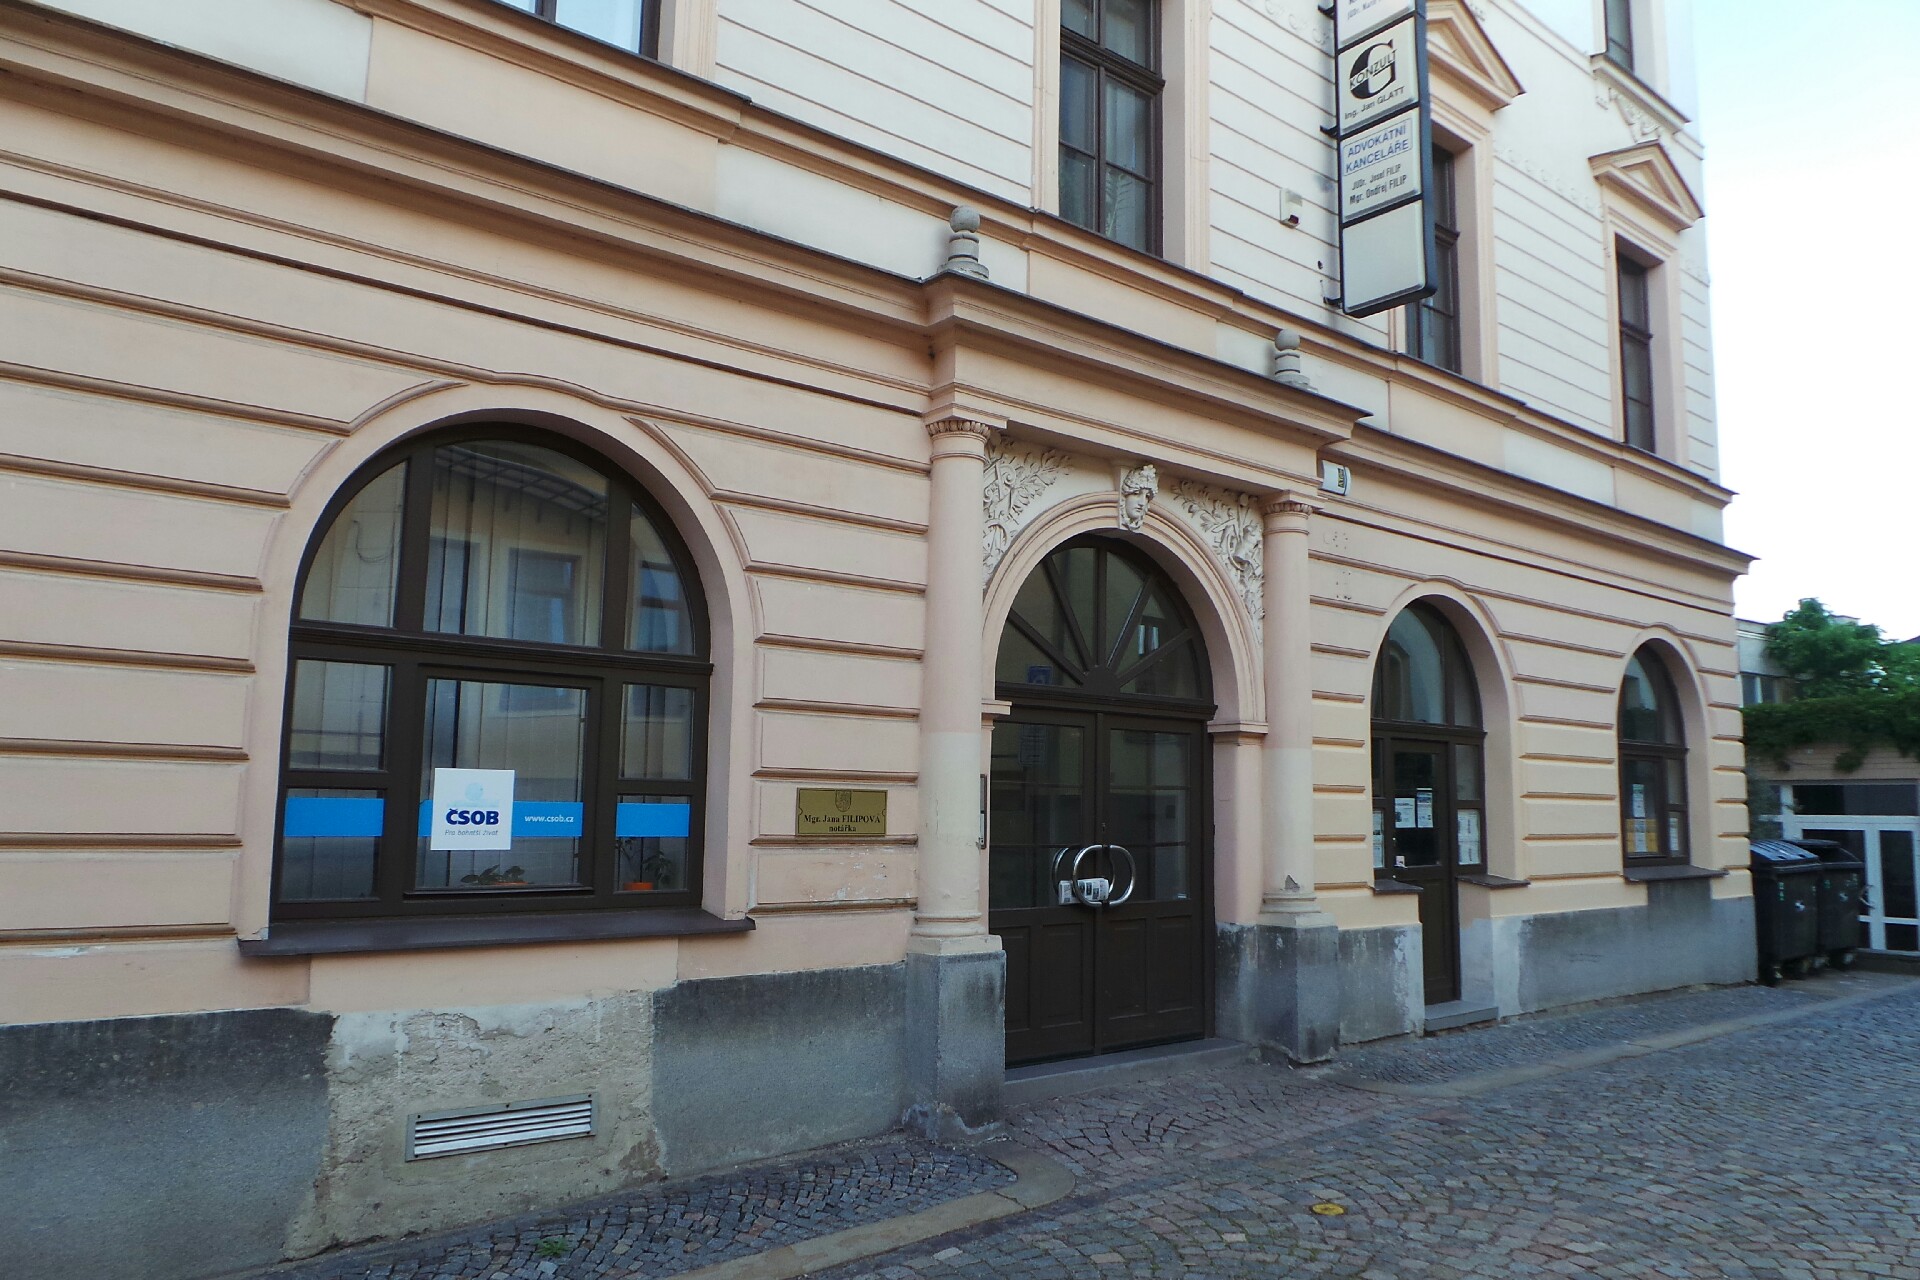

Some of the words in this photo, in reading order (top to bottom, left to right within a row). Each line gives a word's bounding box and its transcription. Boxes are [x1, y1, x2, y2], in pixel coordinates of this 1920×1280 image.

[1350, 49, 1397, 88] KONZULT
[1345, 110, 1358, 120] Ing.
[1361, 102, 1376, 112] Jan
[1377, 86, 1405, 105] GLATT
[1347, 121, 1407, 157] ADVOKÁTNÍ
[1346, 138, 1409, 173] KANCELÁŘE
[1386, 163, 1402, 176] FILIP
[1350, 193, 1364, 205] Mgr.
[1366, 182, 1387, 199] Ondřej
[1389, 174, 1407, 189] FILIP
[445, 808, 500, 826] ČSOB
[524, 814, 574, 823] www.csob.cz
[804, 814, 821, 824] Mgr.
[822, 815, 840, 823] Jana
[842, 813, 881, 823] FILIPOVÁ
[829, 824, 857, 832] notářka
